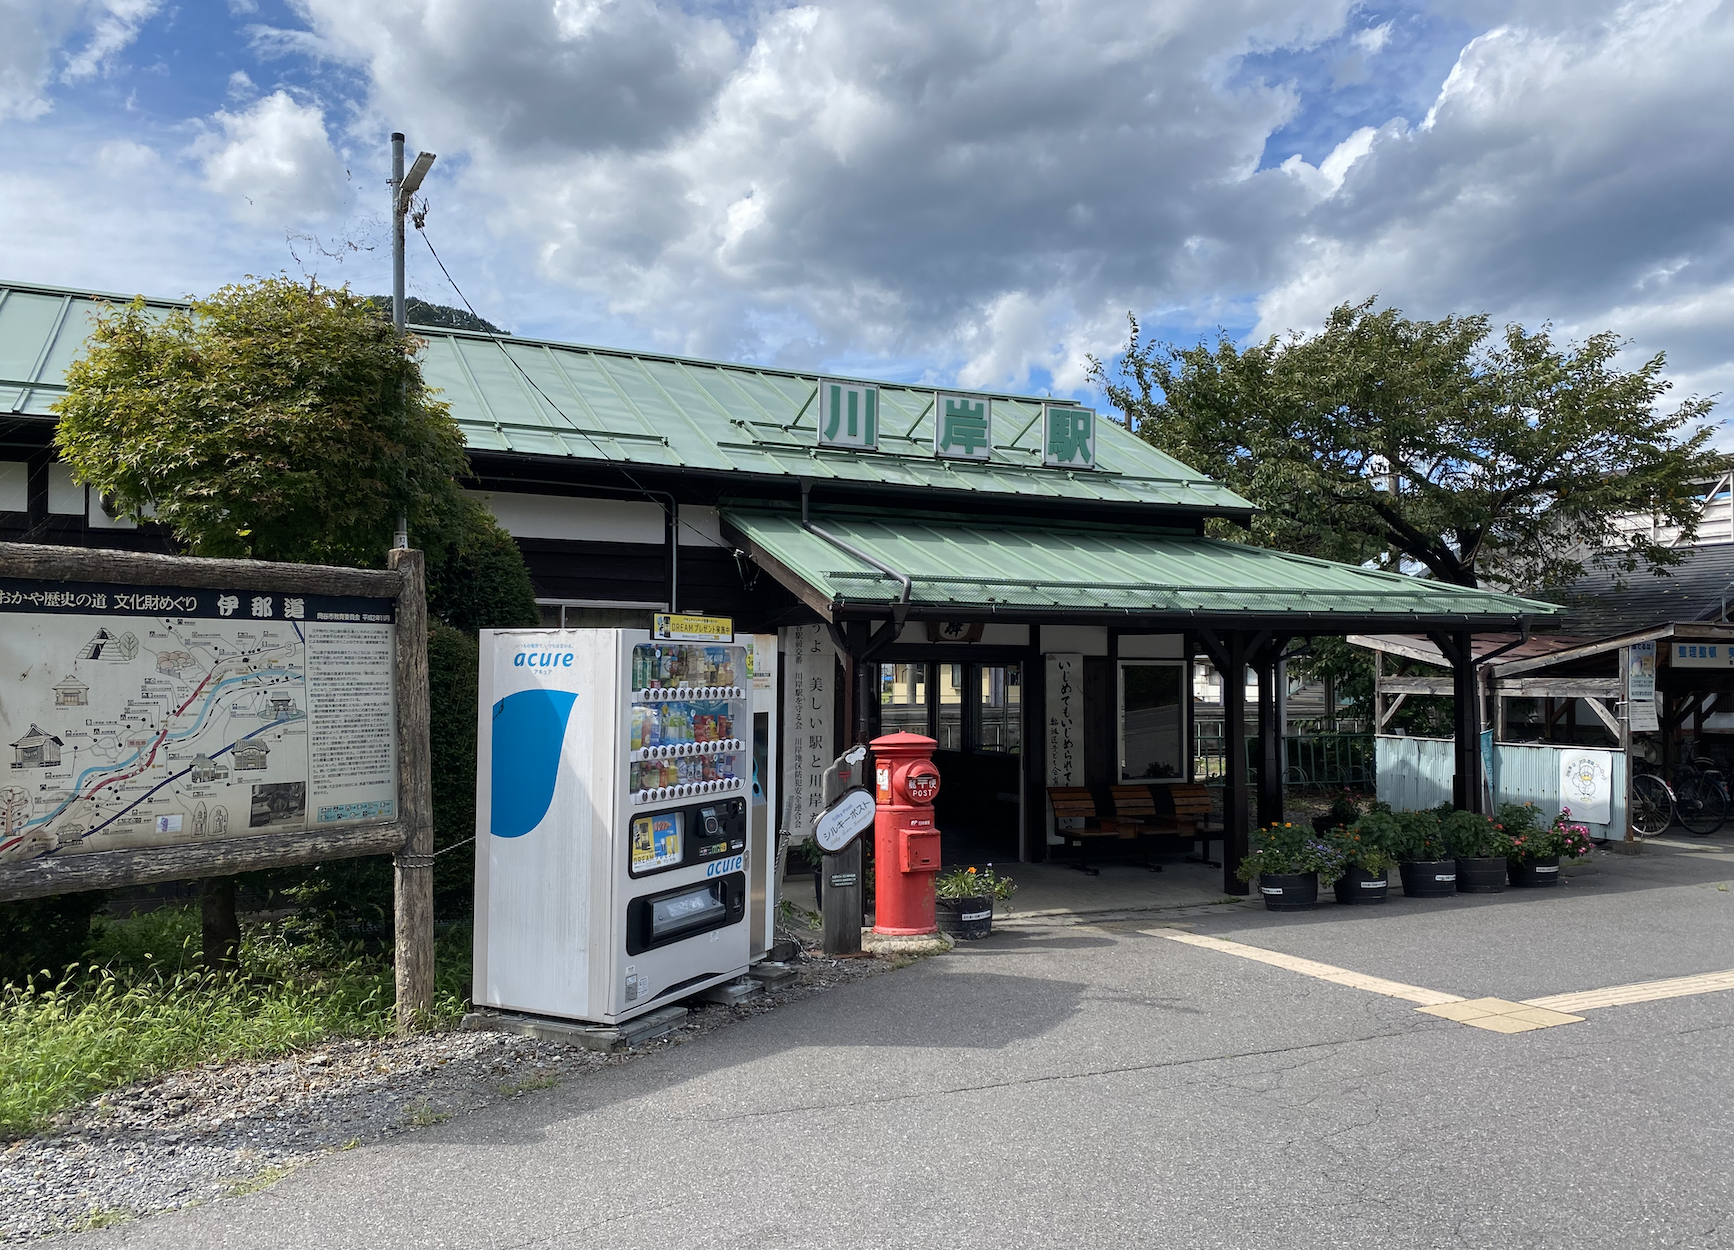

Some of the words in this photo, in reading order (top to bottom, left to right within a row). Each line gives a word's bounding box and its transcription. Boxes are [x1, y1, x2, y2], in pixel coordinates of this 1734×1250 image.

[824, 384, 1092, 464] 川岸駅
[0, 590, 108, 609] おかや歴史の道
[113, 593, 198, 612] 文化財めぐり
[514, 652, 575, 667] acure
[1678, 645, 1718, 658] 整理整頓
[912, 789, 933, 798] POST
[823, 800, 871, 841] シルキーポスト
[707, 856, 743, 877] acure
